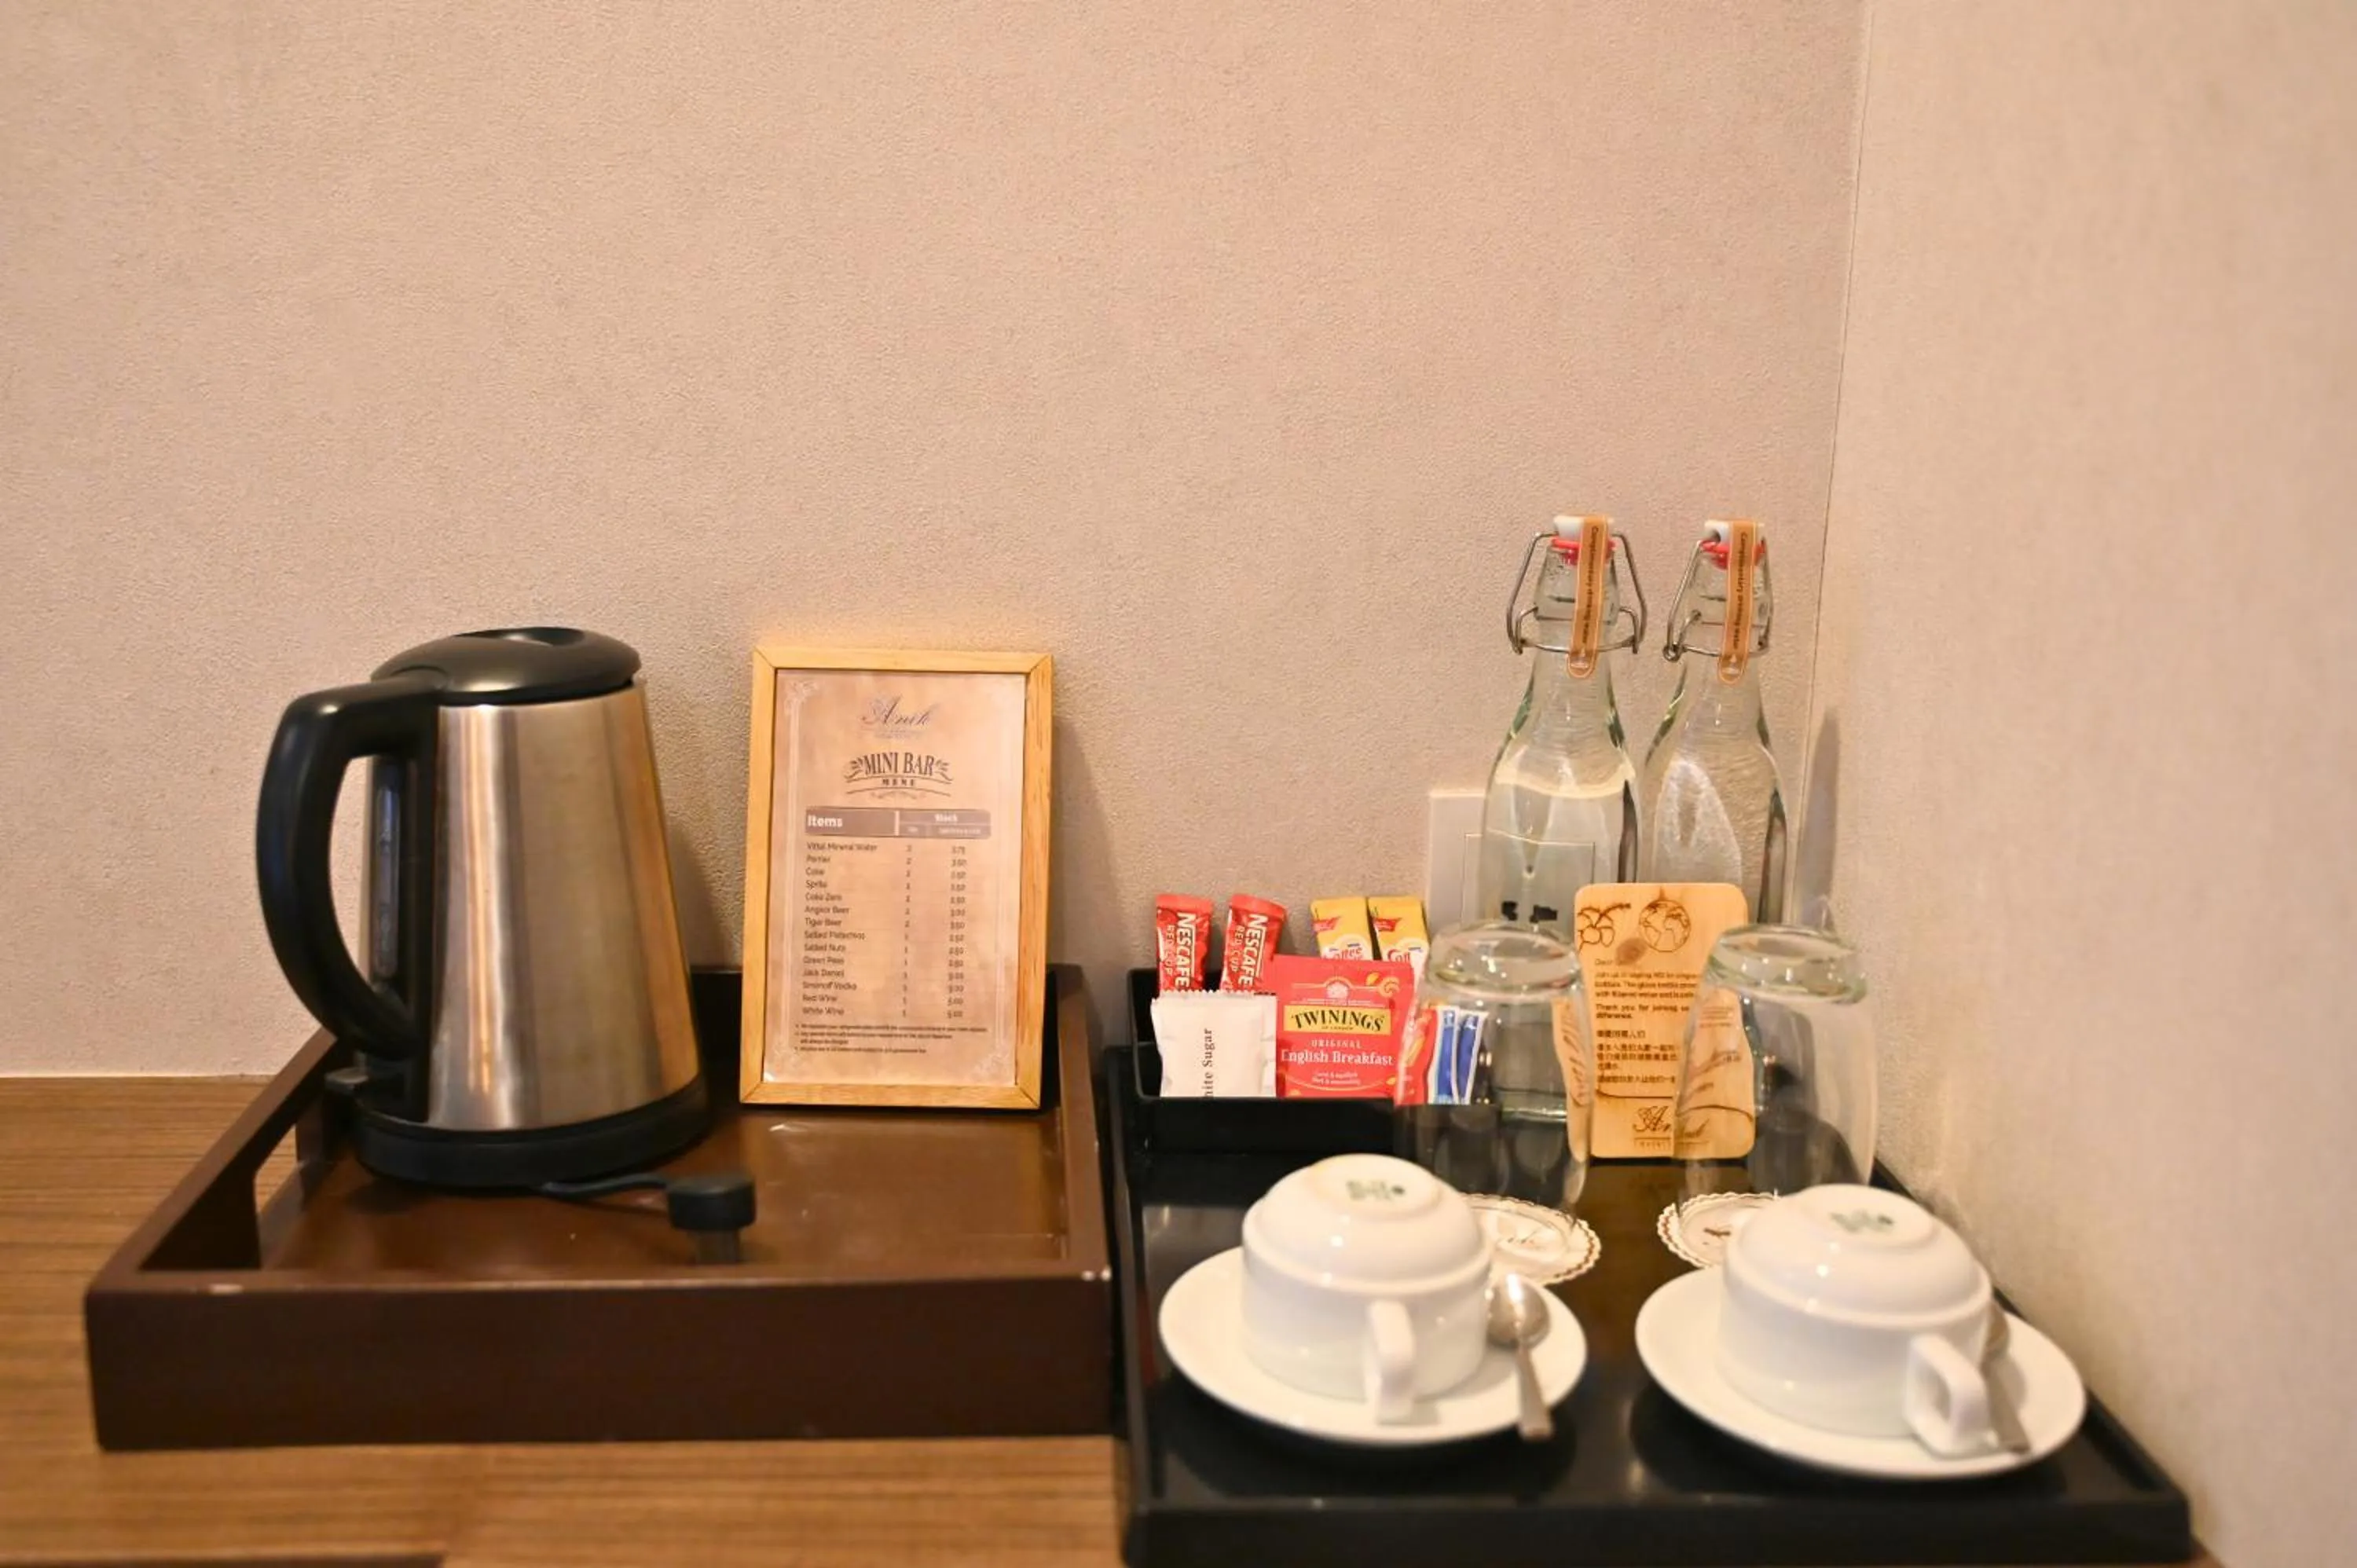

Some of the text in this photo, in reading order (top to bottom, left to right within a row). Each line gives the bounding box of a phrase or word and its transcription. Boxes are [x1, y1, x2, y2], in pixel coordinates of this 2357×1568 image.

[863, 752, 934, 776] MINI BAR
[807, 814, 843, 828] Items
[1164, 925, 1175, 976] RED CUP
[1230, 925, 1245, 973] RED CUP
[1291, 1009, 1385, 1031] TWININGS
[1202, 1028, 1215, 1068] Sugar
[1310, 1039, 1362, 1050] ORIGINAL
[1281, 1049, 1395, 1066] English Breakfast
